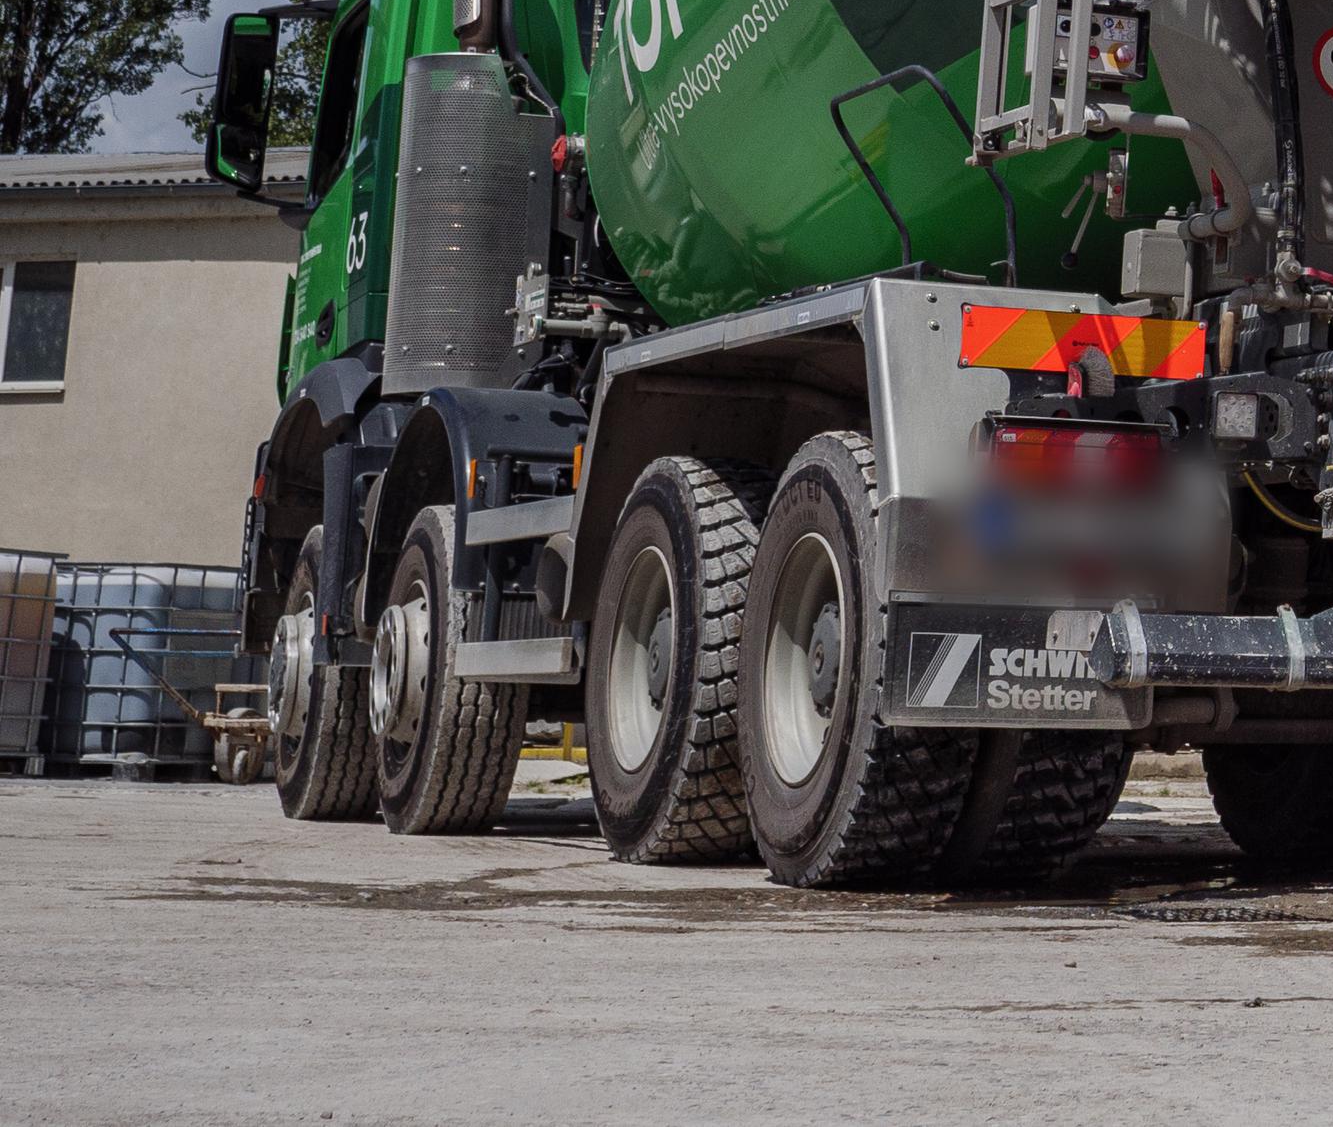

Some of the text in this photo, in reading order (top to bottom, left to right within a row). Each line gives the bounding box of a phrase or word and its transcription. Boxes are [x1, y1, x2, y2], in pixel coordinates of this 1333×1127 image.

[346, 211, 369, 274] 63
[988, 648, 1096, 679] SCHWI
[986, 680, 1098, 711] Stetter
